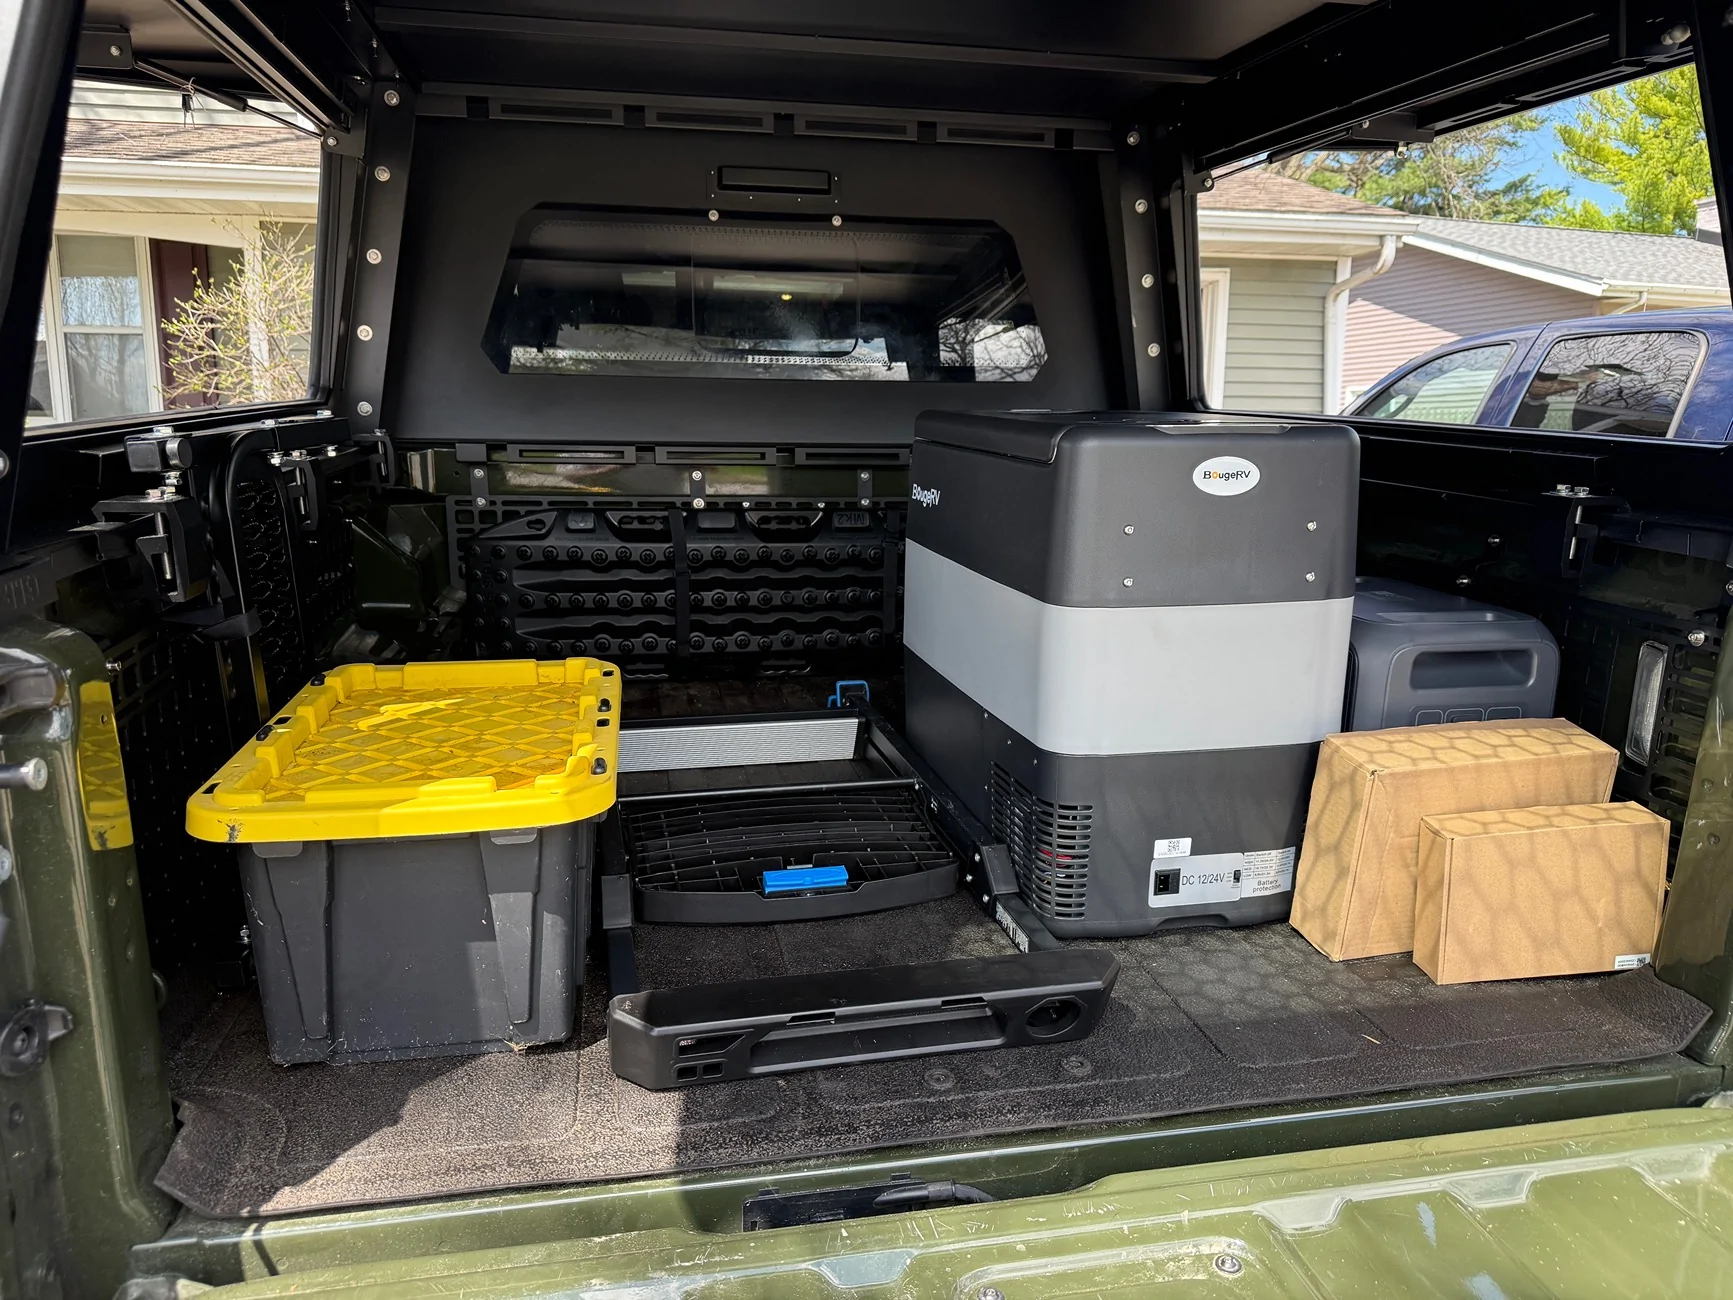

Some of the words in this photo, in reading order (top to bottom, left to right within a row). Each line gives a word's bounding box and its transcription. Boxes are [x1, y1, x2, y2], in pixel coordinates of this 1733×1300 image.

[1202, 469, 1251, 481] BougeRV
[911, 483, 941, 507] BougeRV
[1182, 875, 1195, 886] DC
[1198, 872, 1225, 885] 12/24V
[1252, 884, 1282, 893] protection
